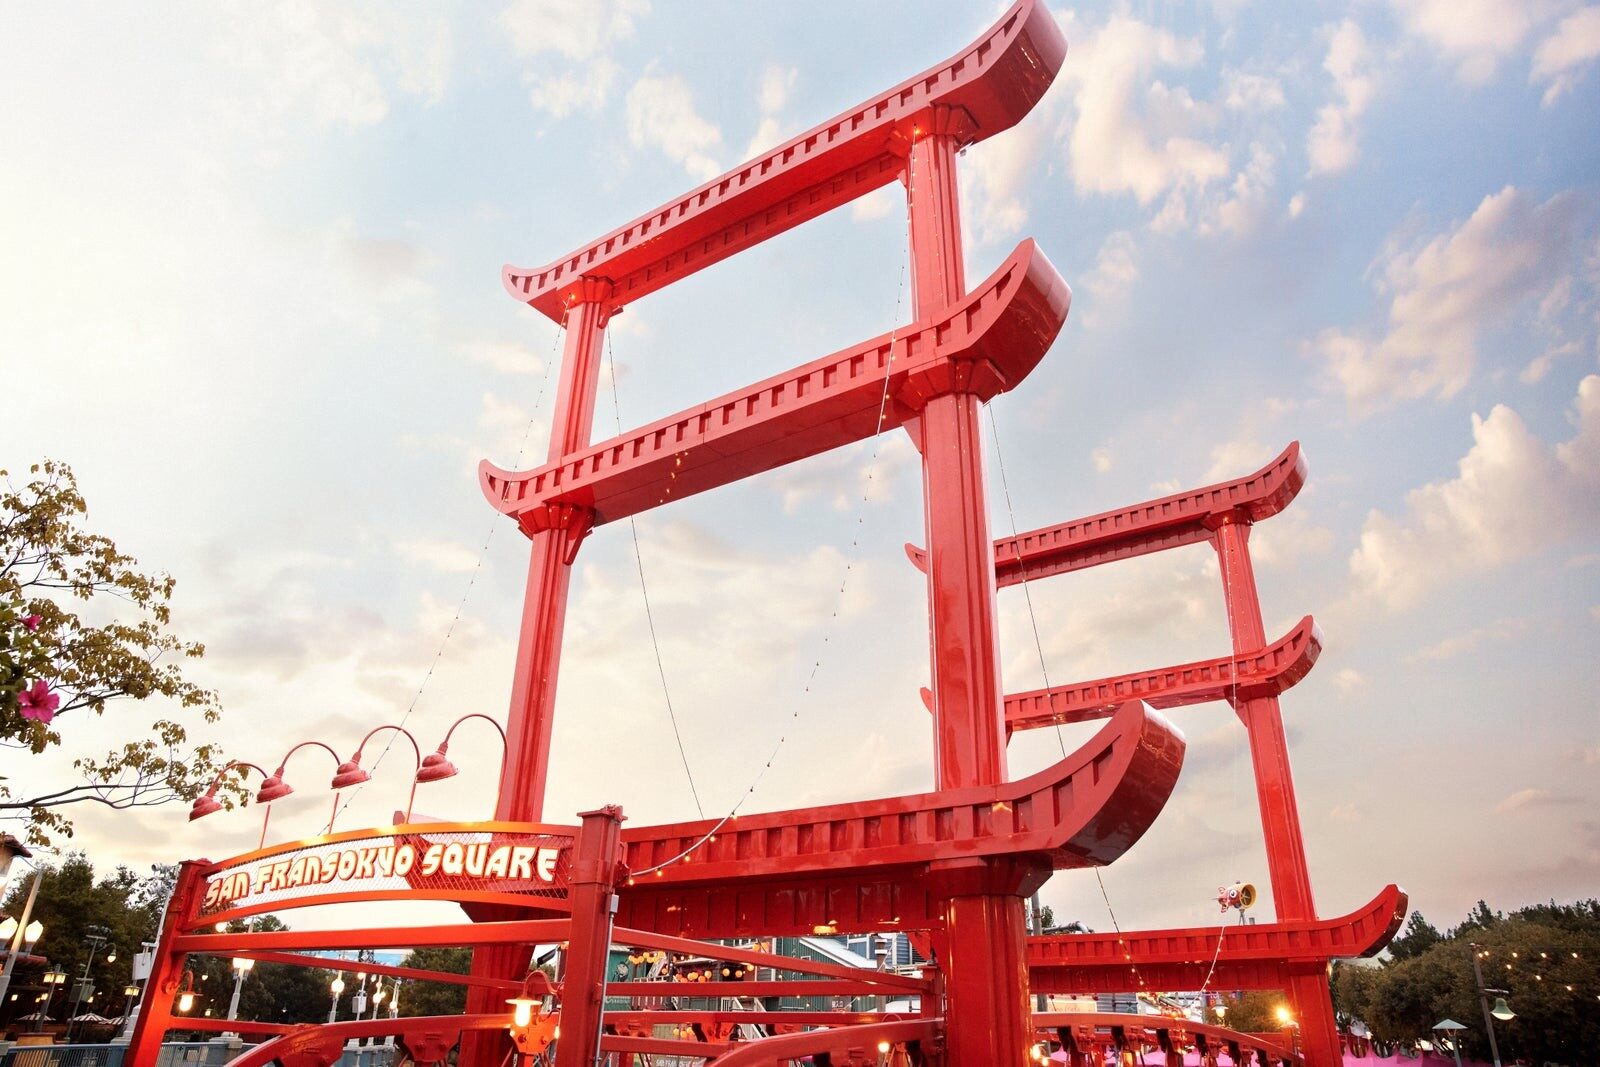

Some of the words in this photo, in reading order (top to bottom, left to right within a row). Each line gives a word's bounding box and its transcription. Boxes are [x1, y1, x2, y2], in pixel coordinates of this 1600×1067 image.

[205, 871, 250, 908] SAN
[257, 845, 415, 893] FRANSOKYO
[423, 842, 559, 881] SQUARE
